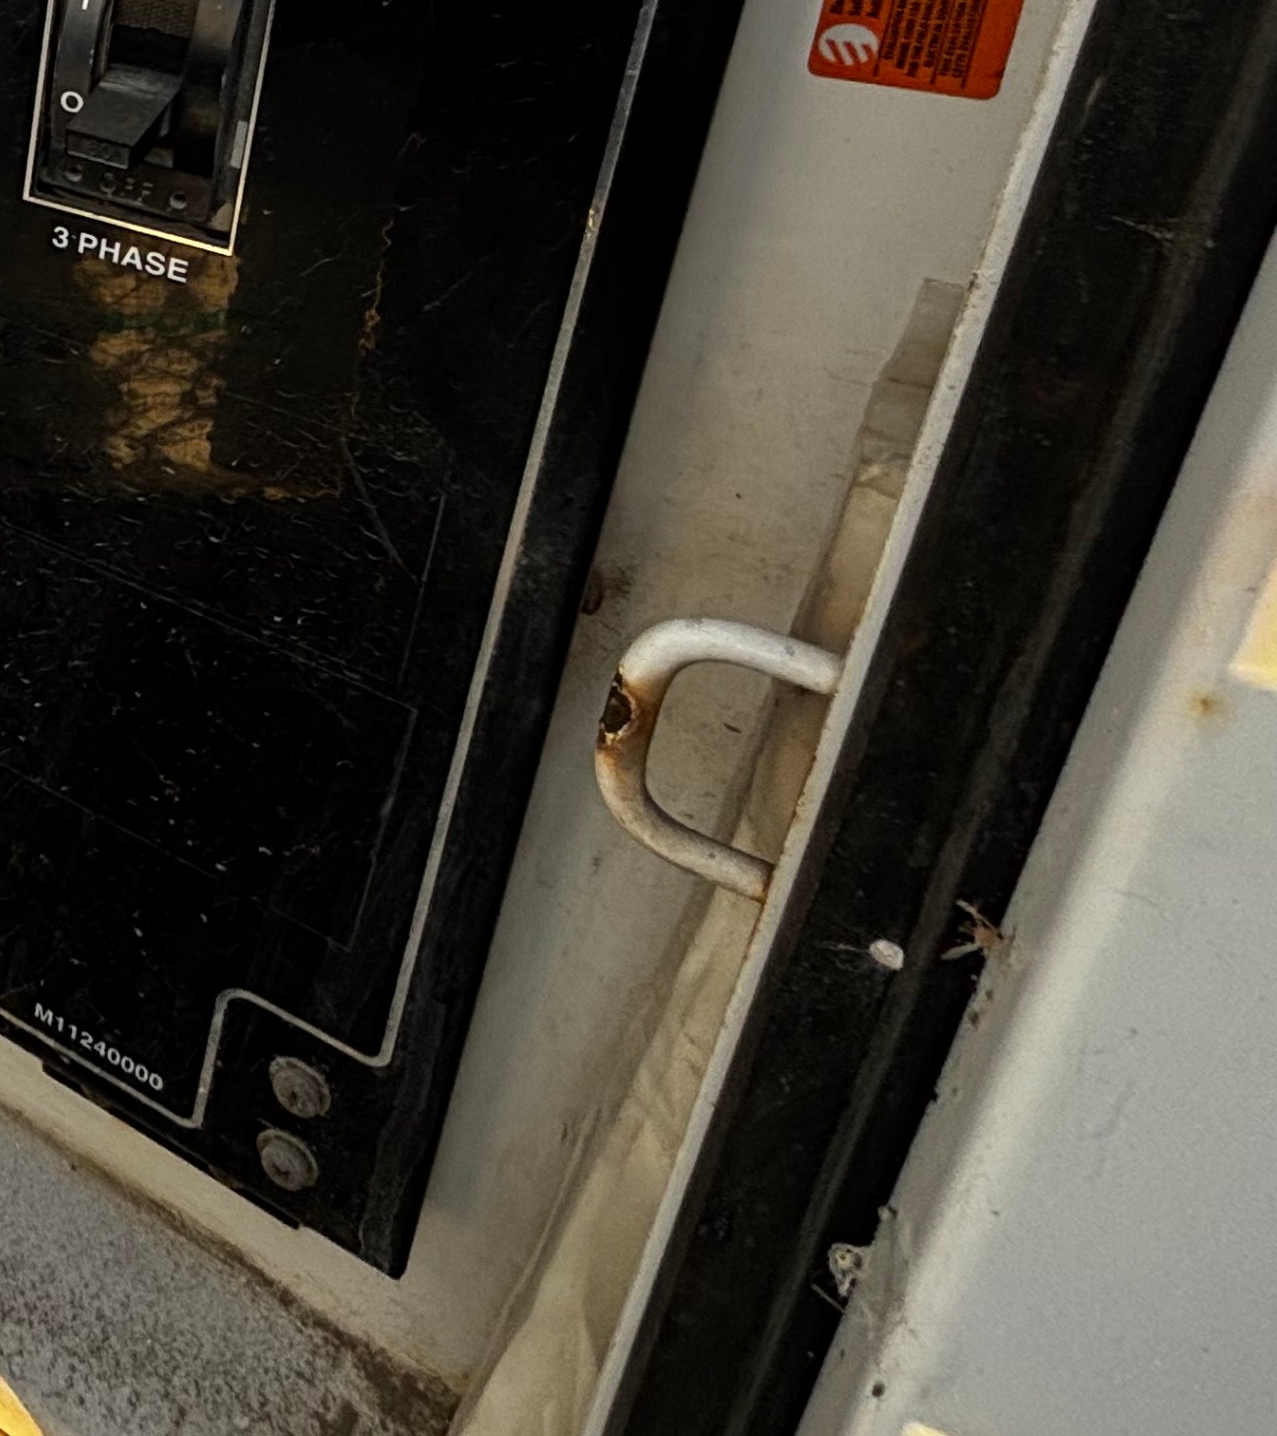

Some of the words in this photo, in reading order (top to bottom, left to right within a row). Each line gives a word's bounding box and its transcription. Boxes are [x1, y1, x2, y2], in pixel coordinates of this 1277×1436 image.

[52, 225, 69, 249] 3
[77, 232, 189, 284] PHASE
[34, 1002, 164, 1092] M11240000
